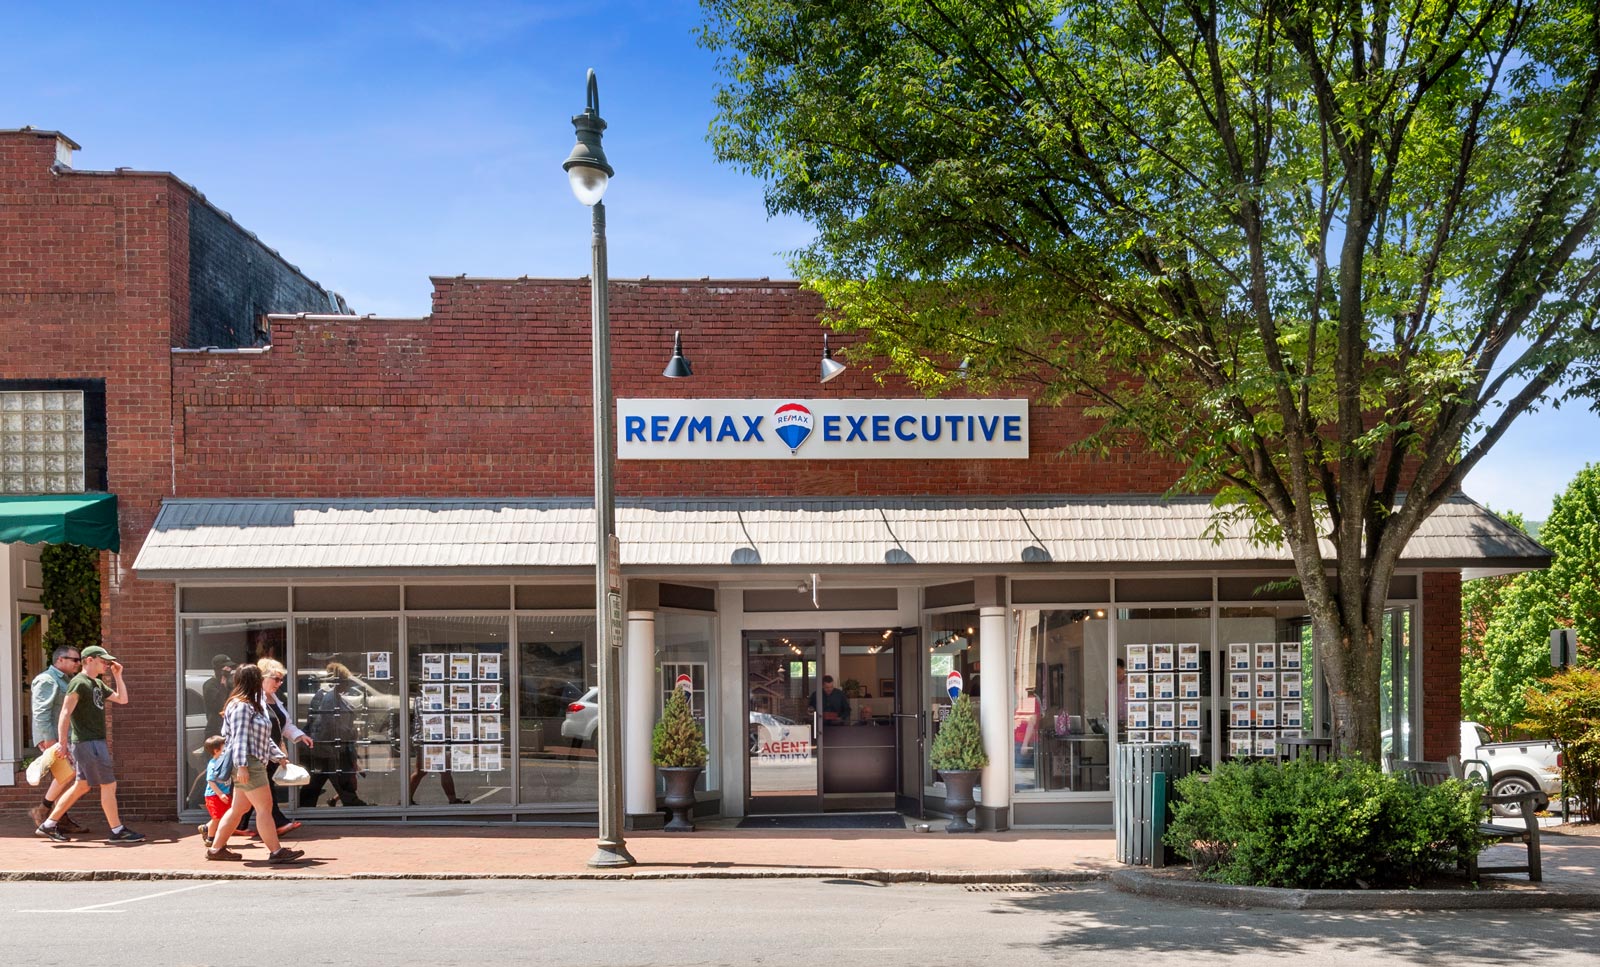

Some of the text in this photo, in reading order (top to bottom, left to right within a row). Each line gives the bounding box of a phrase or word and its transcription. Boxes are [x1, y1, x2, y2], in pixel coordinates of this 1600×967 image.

[777, 415, 809, 424] RE/MAX
[625, 415, 1022, 442] RE/MAX EXECUTIVE
[762, 741, 809, 753] AGENT
[780, 753, 809, 762] DUTY
